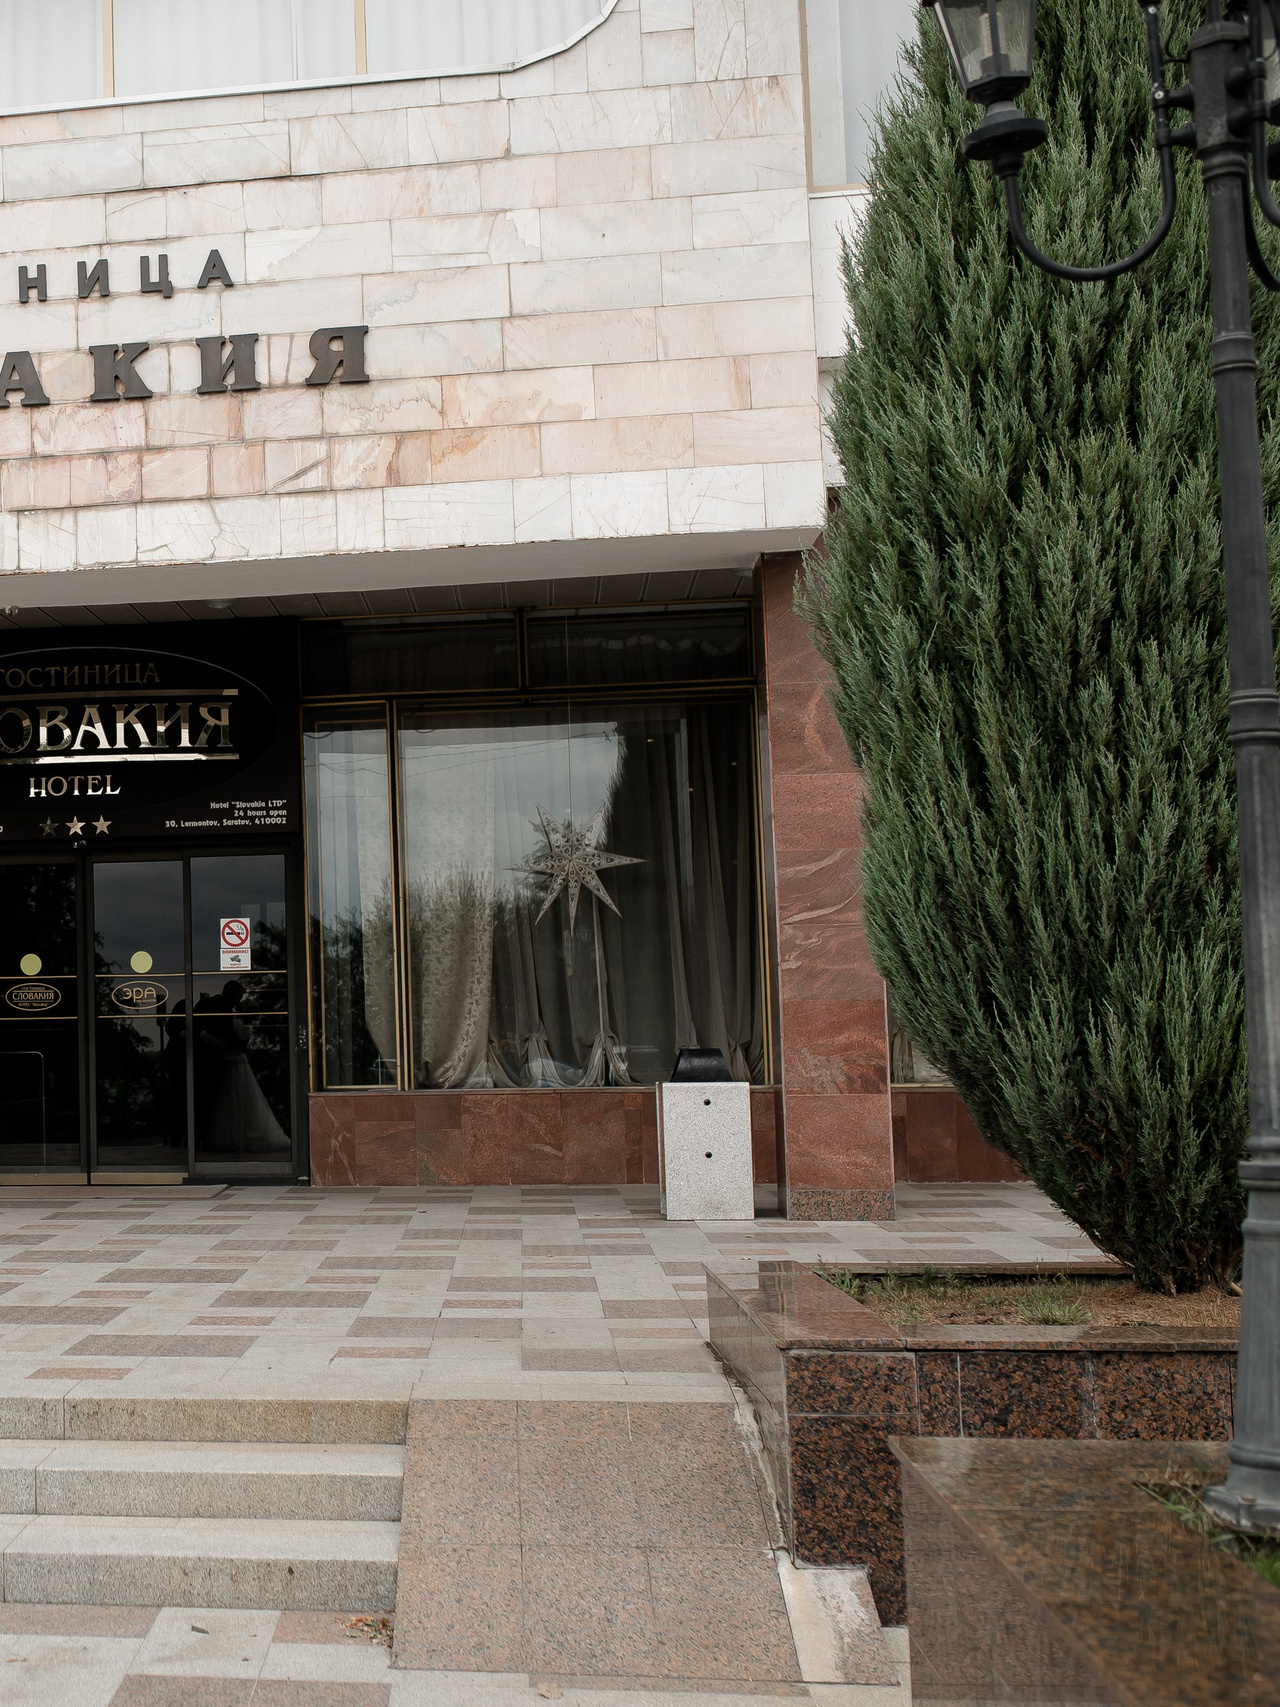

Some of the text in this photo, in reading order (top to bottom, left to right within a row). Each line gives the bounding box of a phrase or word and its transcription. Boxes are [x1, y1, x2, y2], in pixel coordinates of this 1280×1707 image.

[29, 774, 121, 797] HOTEL
[269, 809, 287, 817] open
[12, 992, 54, 1000] СЛОВАКИЯ
